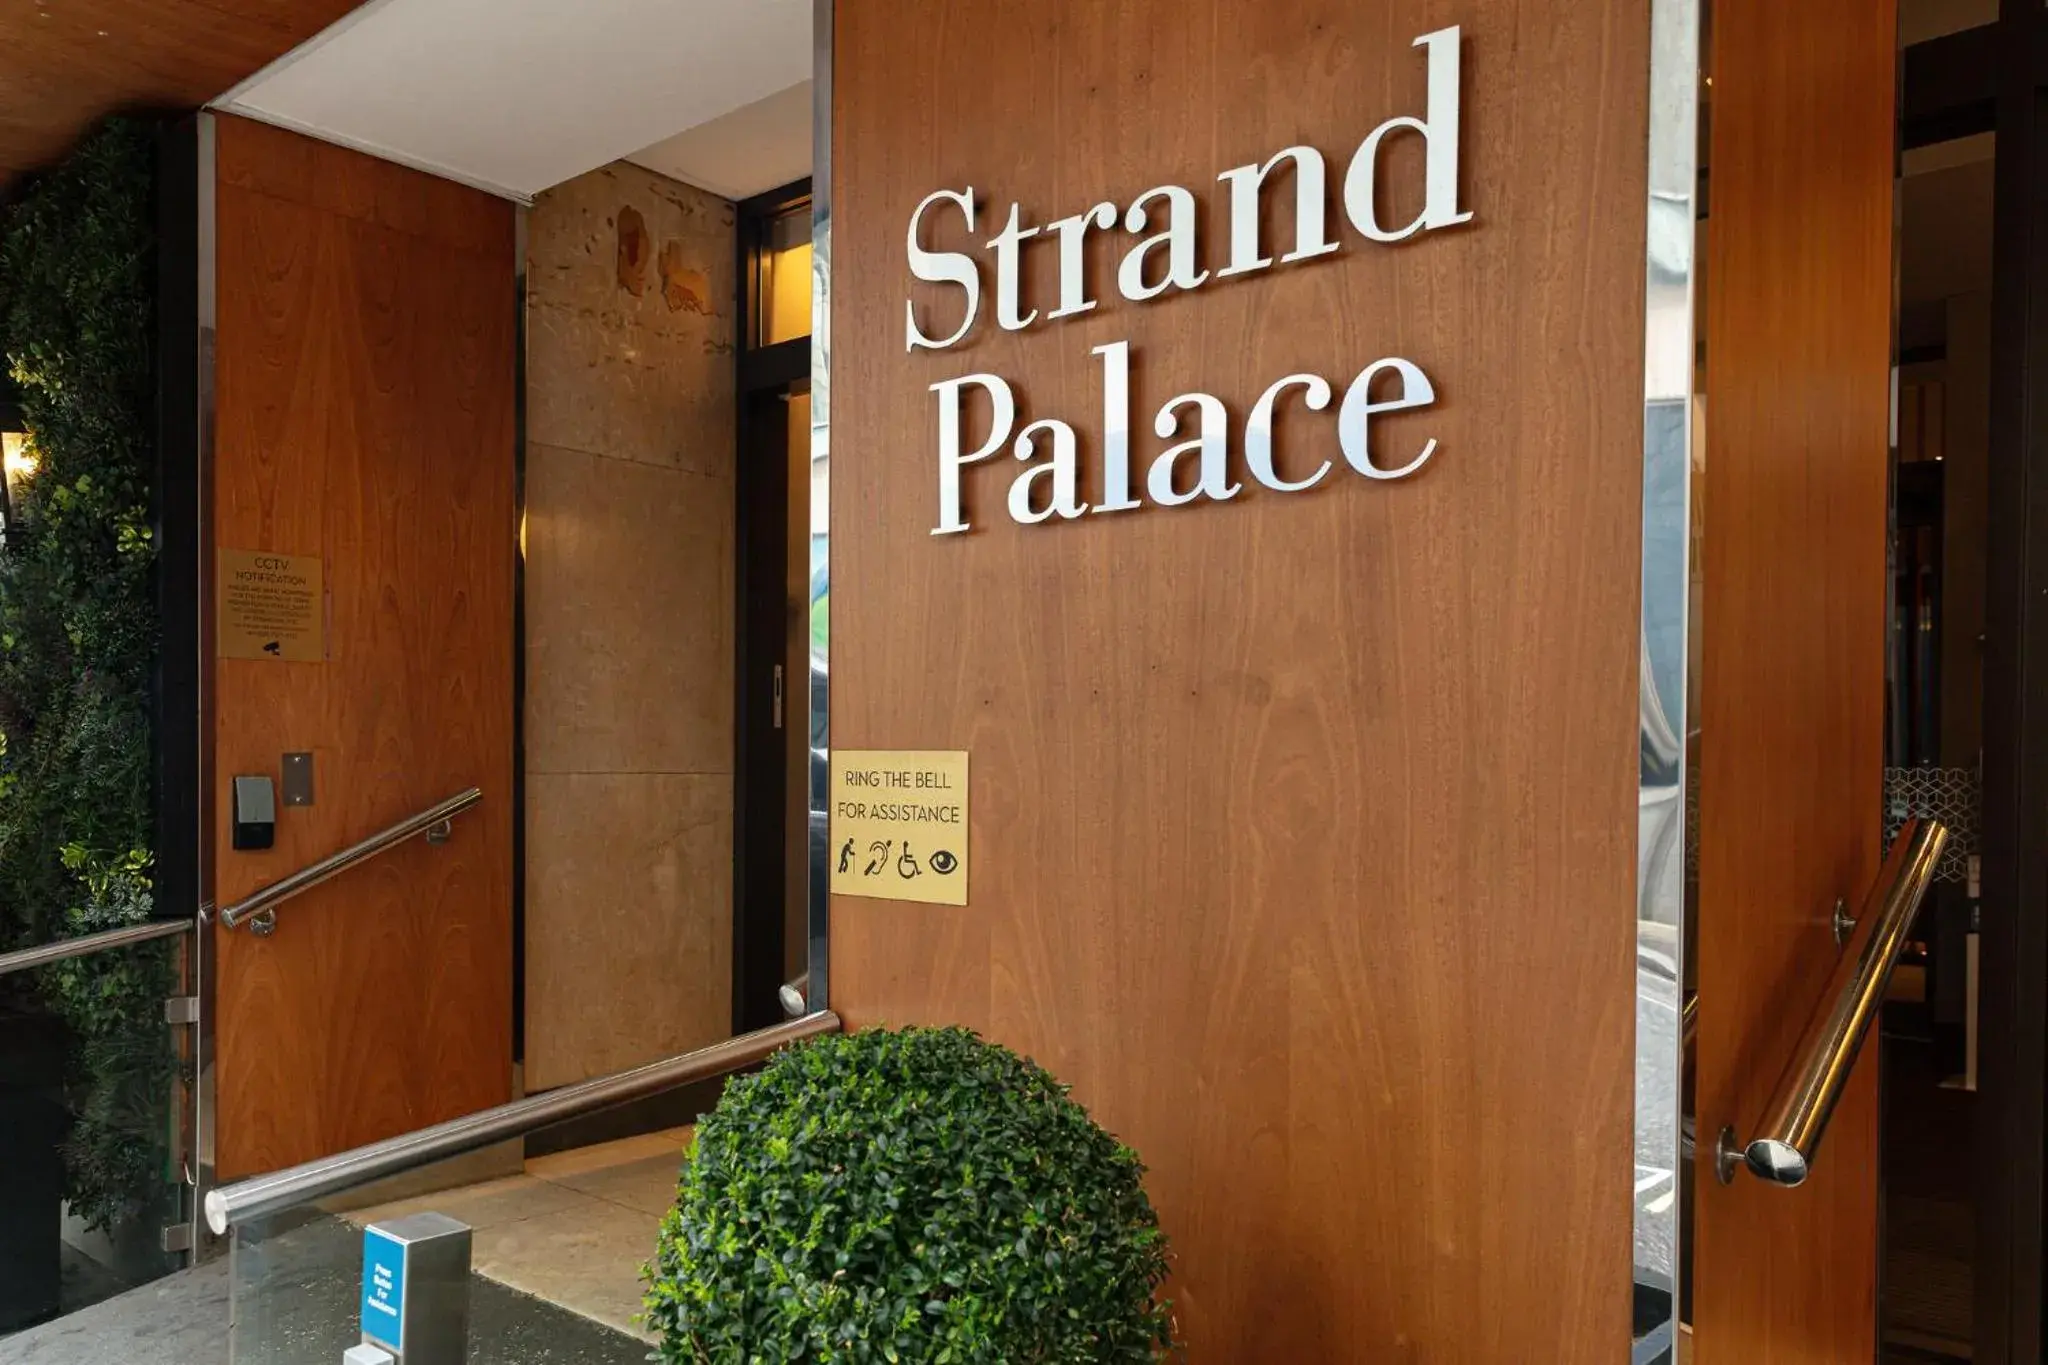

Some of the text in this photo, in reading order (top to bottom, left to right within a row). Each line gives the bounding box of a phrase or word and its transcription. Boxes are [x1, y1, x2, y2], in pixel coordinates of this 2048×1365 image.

[906, 24, 1474, 354] Strand
[929, 340, 1437, 536] Palace
[254, 556, 289, 571] CCTV
[235, 570, 307, 586] NOTIFICATION
[845, 770, 952, 789] RING THE BELL
[838, 801, 960, 824] FOR ASSISTANCE
